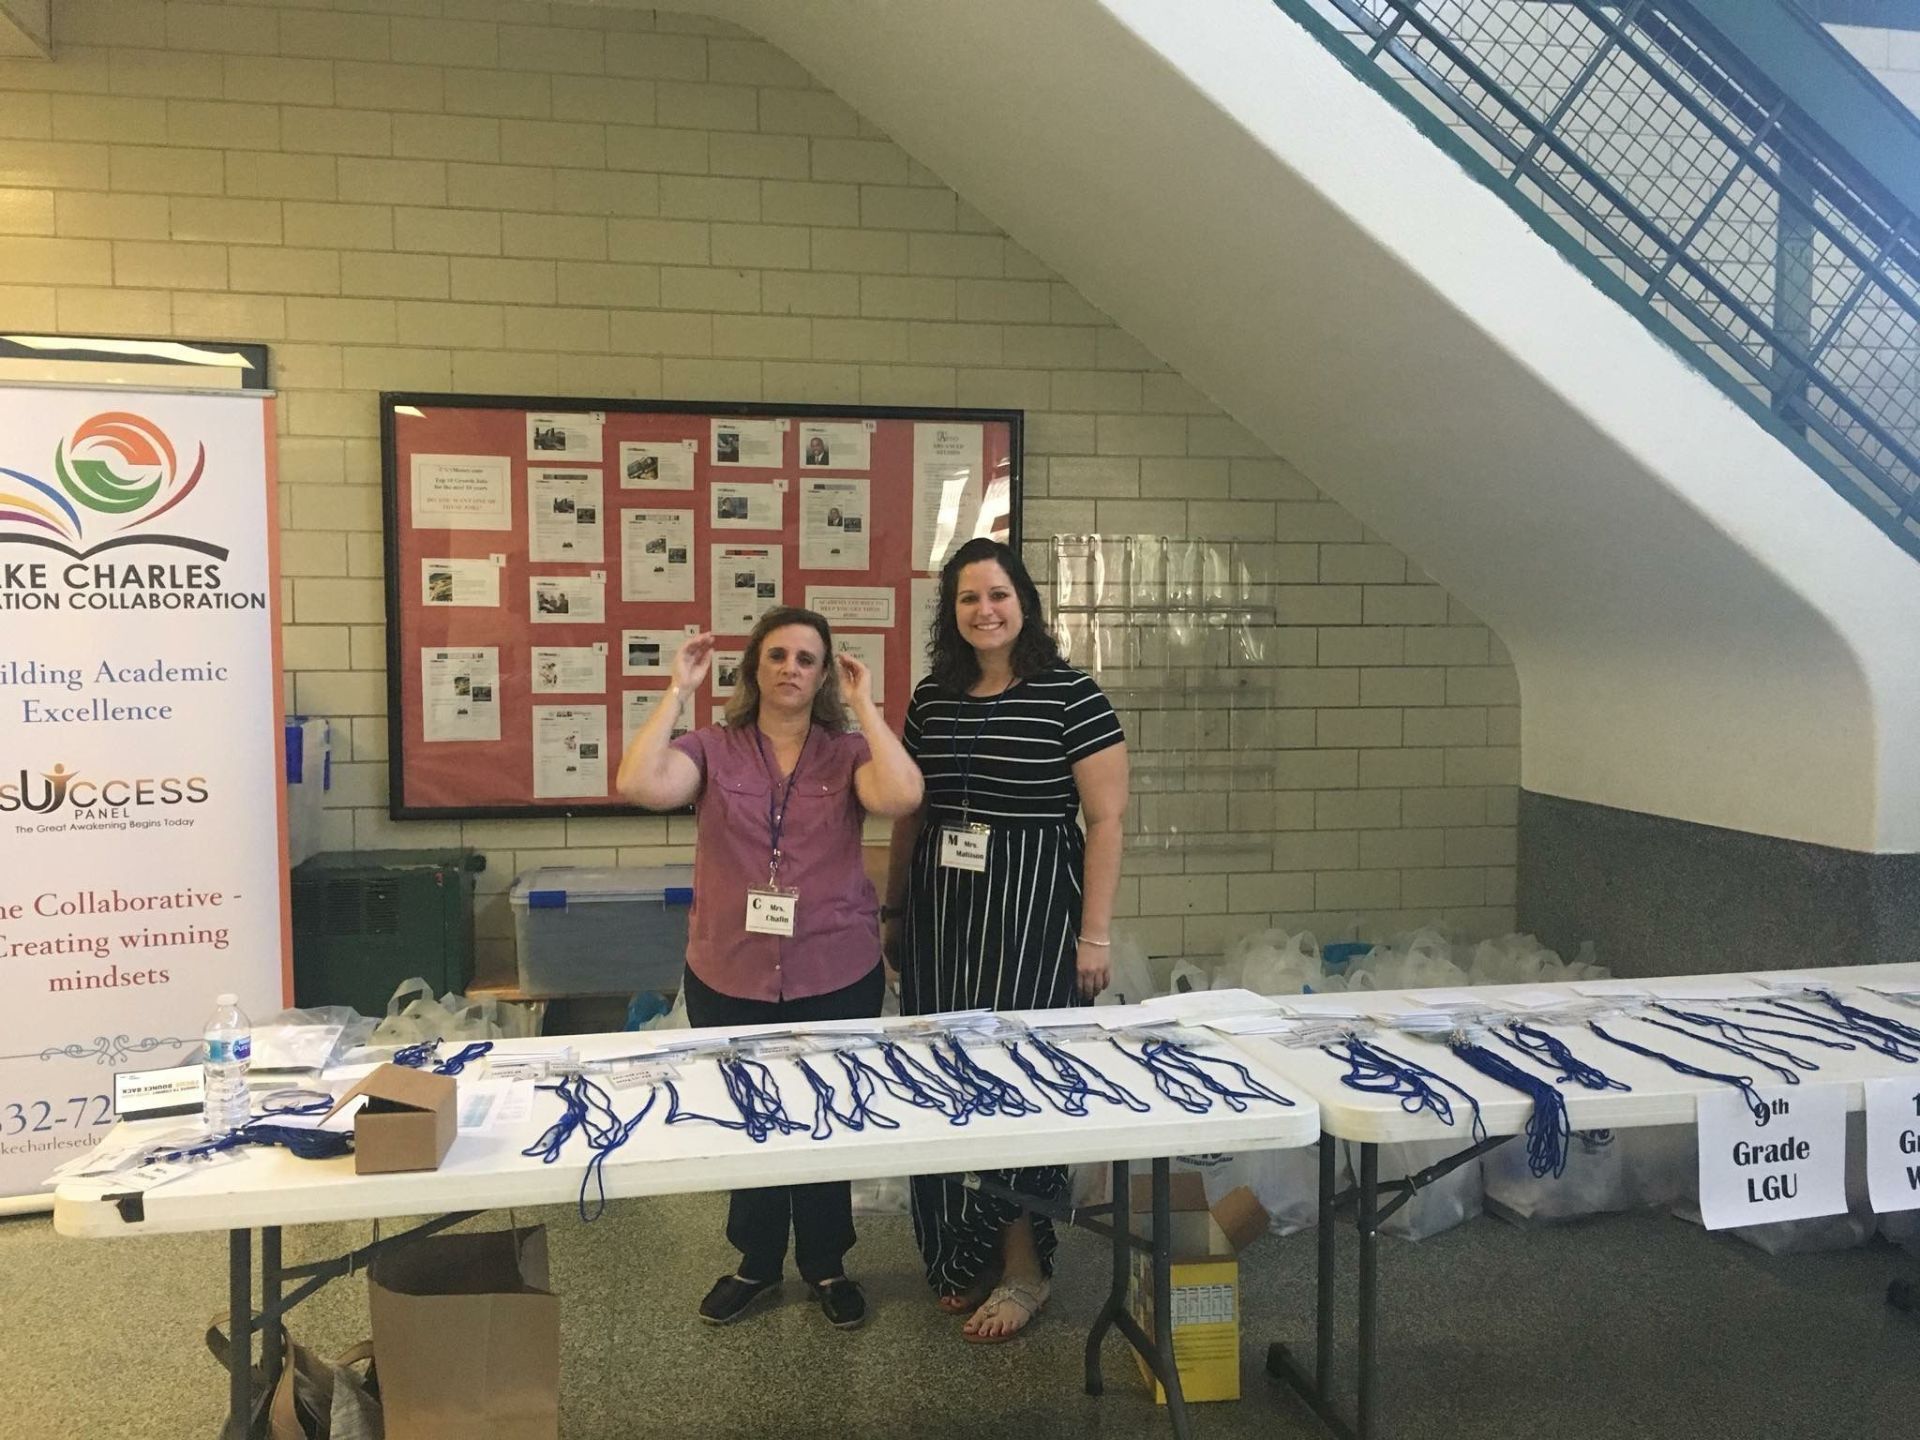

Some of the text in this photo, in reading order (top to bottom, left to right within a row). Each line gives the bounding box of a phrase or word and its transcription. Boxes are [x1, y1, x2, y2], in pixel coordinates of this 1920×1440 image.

[0, 563, 221, 590] KE CHARLES
[0, 592, 266, 610] TION COLLABORATION
[94, 660, 228, 684] Academic
[22, 698, 172, 723] Excellence
[15, 818, 195, 834] The Great Awakening Begins Today
[74, 807, 130, 820] PANEL
[948, 834, 958, 846] M
[34, 887, 223, 917] Collaborative
[752, 898, 762, 910] C
[119, 925, 230, 950] winning
[49, 965, 170, 992] mindsets
[0, 1094, 123, 1136] 32-72
[1733, 1136, 1810, 1166] Grade
[1747, 1173, 1798, 1203] LGU
